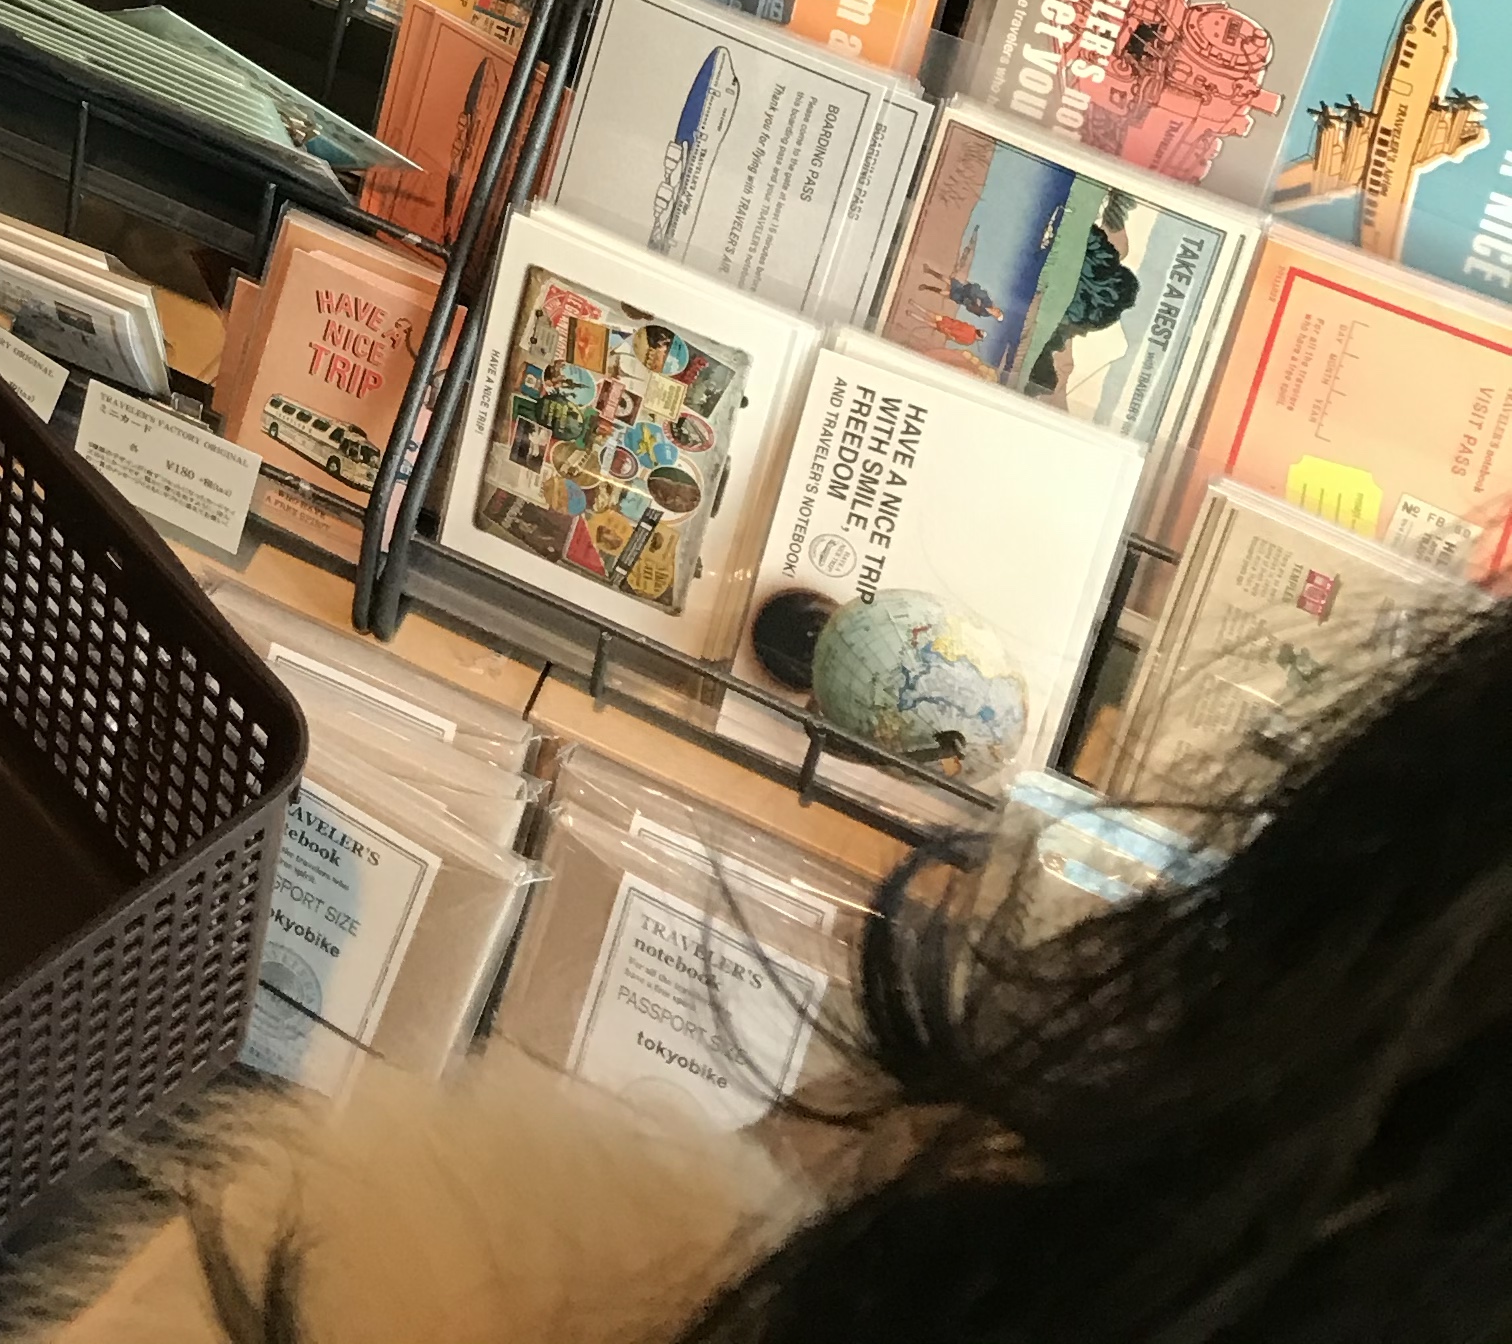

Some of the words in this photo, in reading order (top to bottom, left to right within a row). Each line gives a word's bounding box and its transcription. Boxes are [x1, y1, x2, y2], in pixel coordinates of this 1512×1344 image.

[828, 28, 864, 57] a
[810, 103, 841, 169] BOARDING
[799, 168, 820, 203] PASS
[1168, 234, 1205, 287] TAKE
[315, 289, 386, 333] HAVE
[1162, 282, 1186, 300] A
[322, 318, 386, 366] NICE
[1147, 301, 1181, 352] REST
[308, 341, 384, 399] TRIP
[828, 375, 849, 409] AND
[867, 396, 903, 457] WITH
[891, 402, 928, 470] HAVE
[1470, 386, 1496, 432] VISIT
[805, 411, 840, 496] TRAVELER'S
[826, 384, 877, 502] FREEDOM
[1451, 435, 1478, 477] PASS
[840, 457, 884, 533] SMILE,
[885, 469, 907, 487] A
[781, 496, 816, 579] NOTEBOOK!
[868, 490, 904, 550] NICE
[855, 554, 887, 605] TRIP
[633, 937, 720, 992] notebook
[640, 913, 764, 990] TRAVELER'S
[618, 984, 708, 1041] PASSPORT
[636, 1030, 728, 1089] tokyobike
